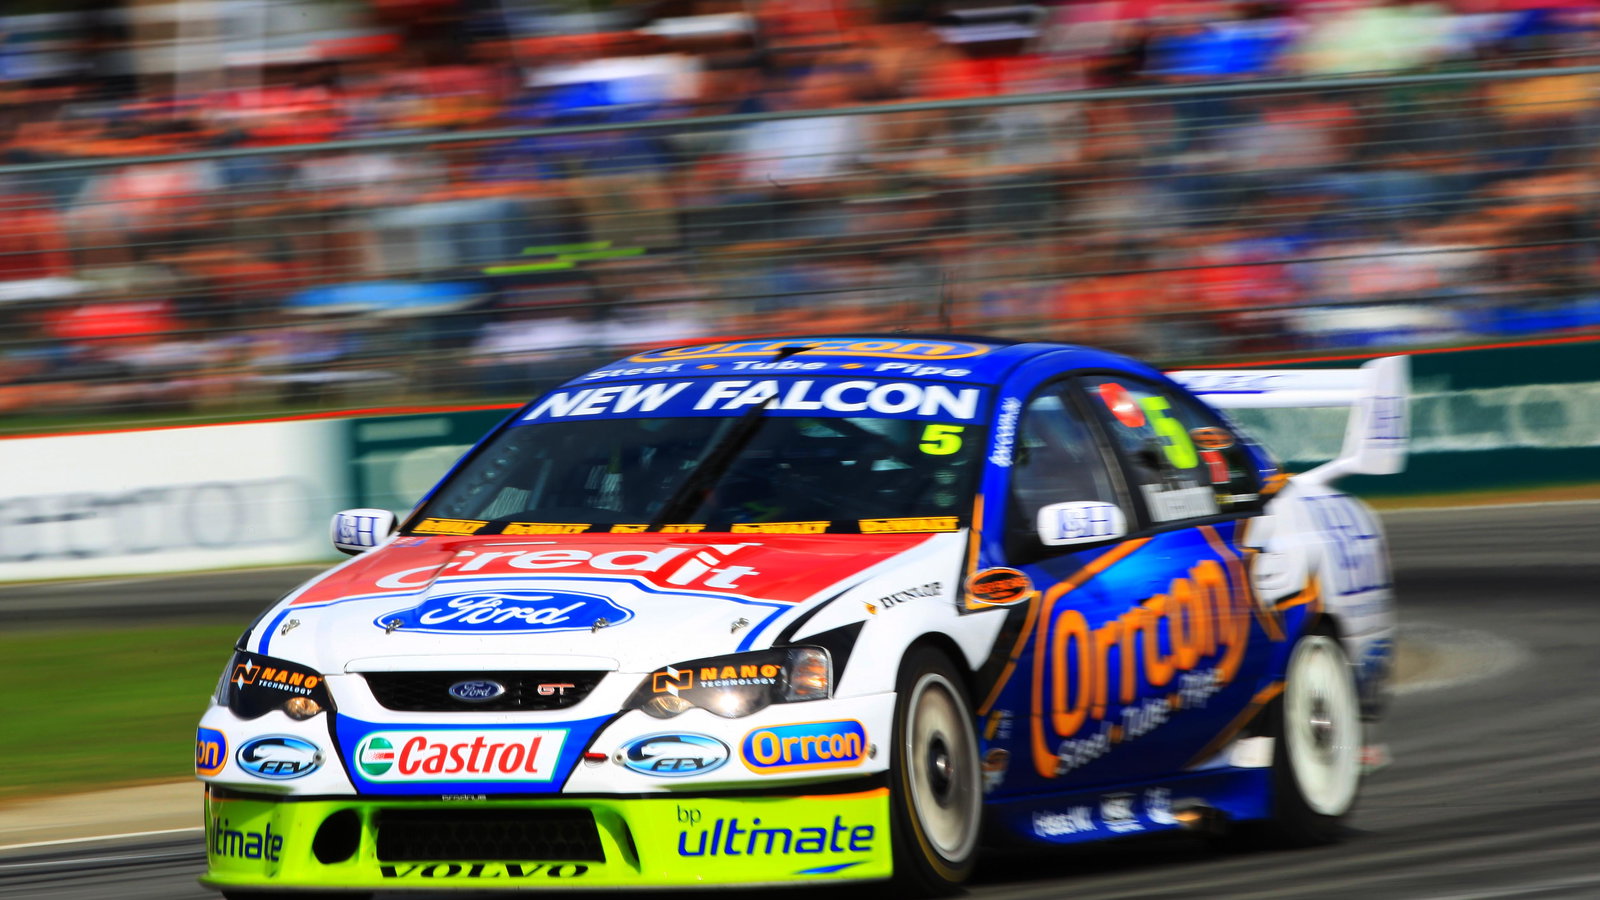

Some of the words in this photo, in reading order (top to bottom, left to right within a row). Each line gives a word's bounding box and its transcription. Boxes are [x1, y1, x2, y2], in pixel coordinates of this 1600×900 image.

[586, 363, 681, 380] Steel
[732, 360, 827, 372] Tube
[875, 361, 972, 378] Pipe
[523, 381, 694, 421] NEW
[694, 379, 980, 420] FALCON
[918, 424, 964, 455] 5
[1137, 396, 1198, 469] 5
[375, 541, 762, 592] credit
[419, 591, 573, 625] Ford
[1052, 560, 1232, 737] Orrcon
[261, 667, 319, 689] NANO
[700, 664, 779, 681] NANO
[700, 678, 777, 688] TECHNOLOGY
[258, 680, 312, 696] TECHNOLOGY
[460, 682, 491, 697] Ford
[537, 683, 575, 696] GT
[398, 736, 542, 775] Castrol
[752, 730, 862, 766] Orrcon
[677, 805, 701, 826] bp
[677, 816, 876, 857] ultimate
[379, 863, 589, 878] VOLVO
